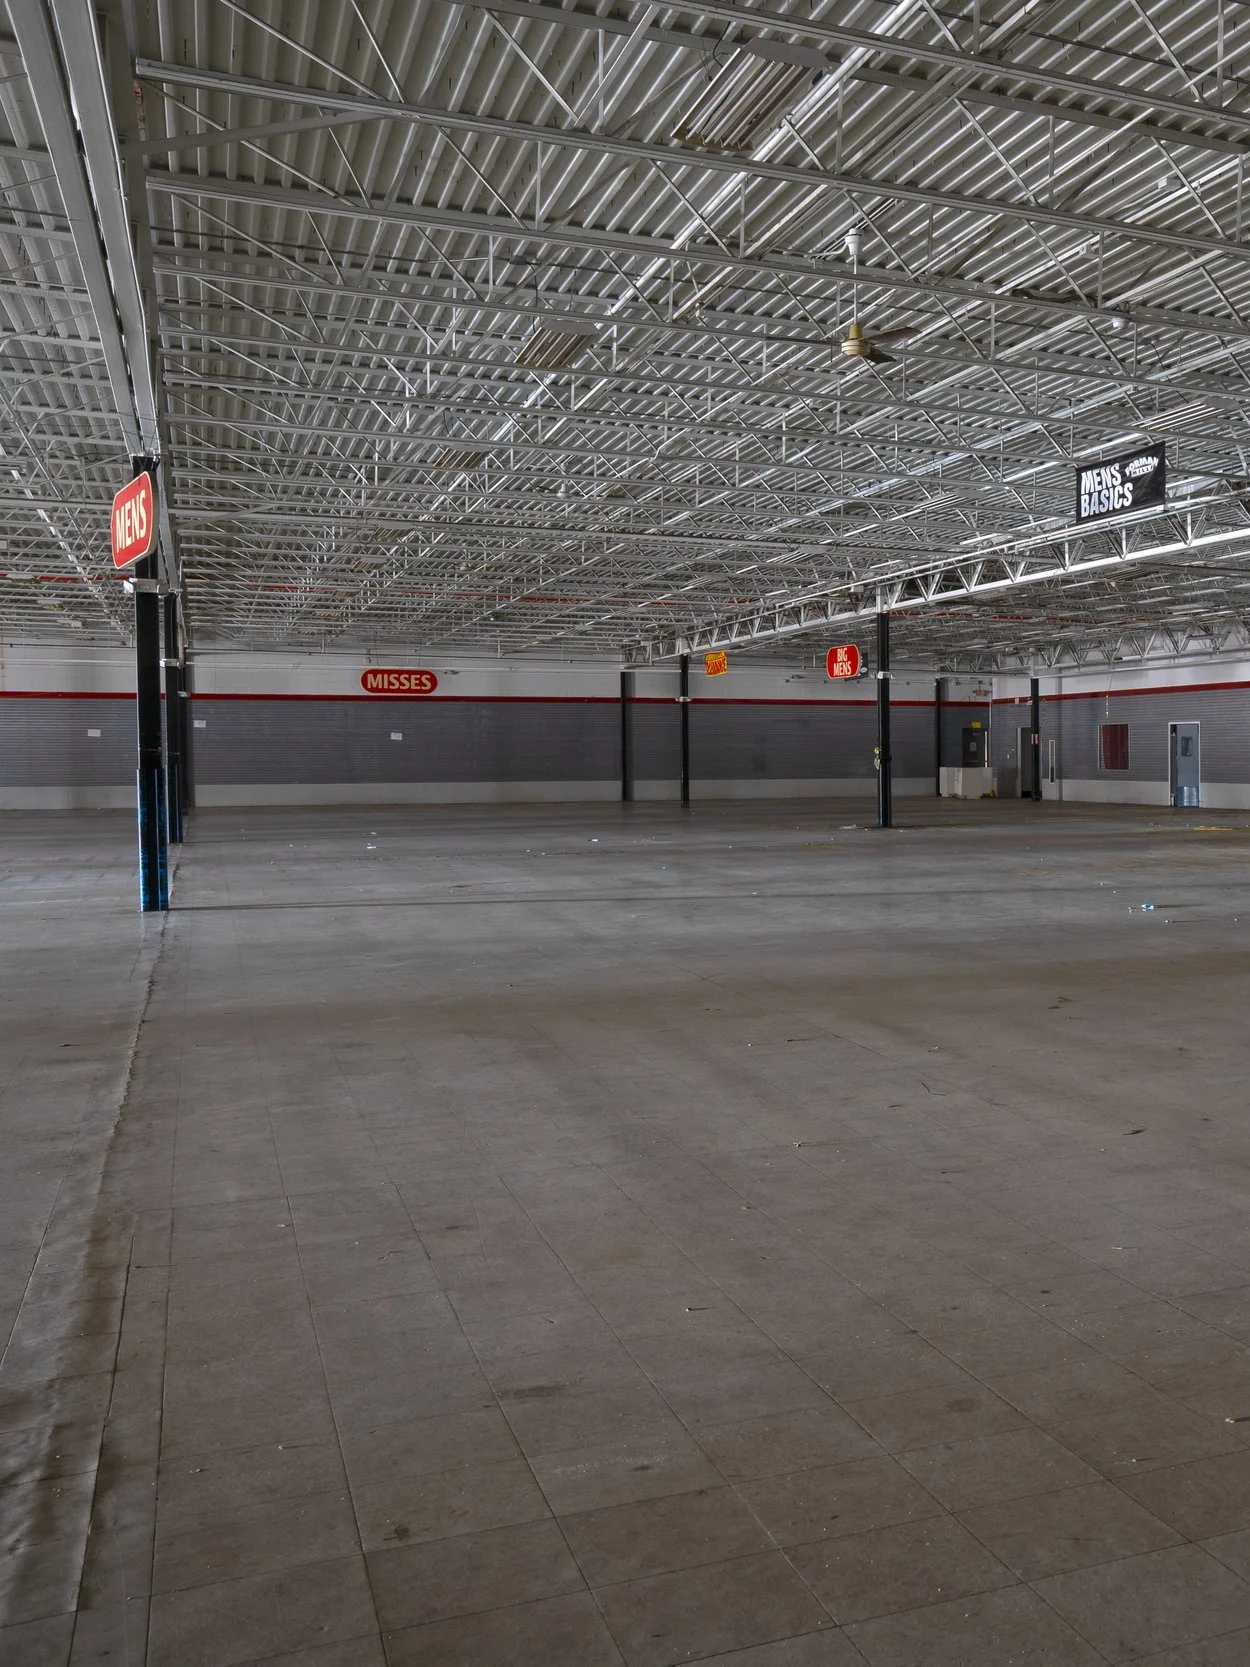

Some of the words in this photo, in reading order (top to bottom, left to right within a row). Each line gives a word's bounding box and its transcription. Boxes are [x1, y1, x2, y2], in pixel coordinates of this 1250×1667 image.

[1124, 456, 1159, 477] FORMAN
[1081, 462, 1122, 495] MENS
[1081, 482, 1134, 518] BASICS
[116, 489, 147, 553] MENS
[836, 647, 848, 662] BIG
[833, 660, 852, 677] MENS
[367, 673, 432, 690] MISSES
